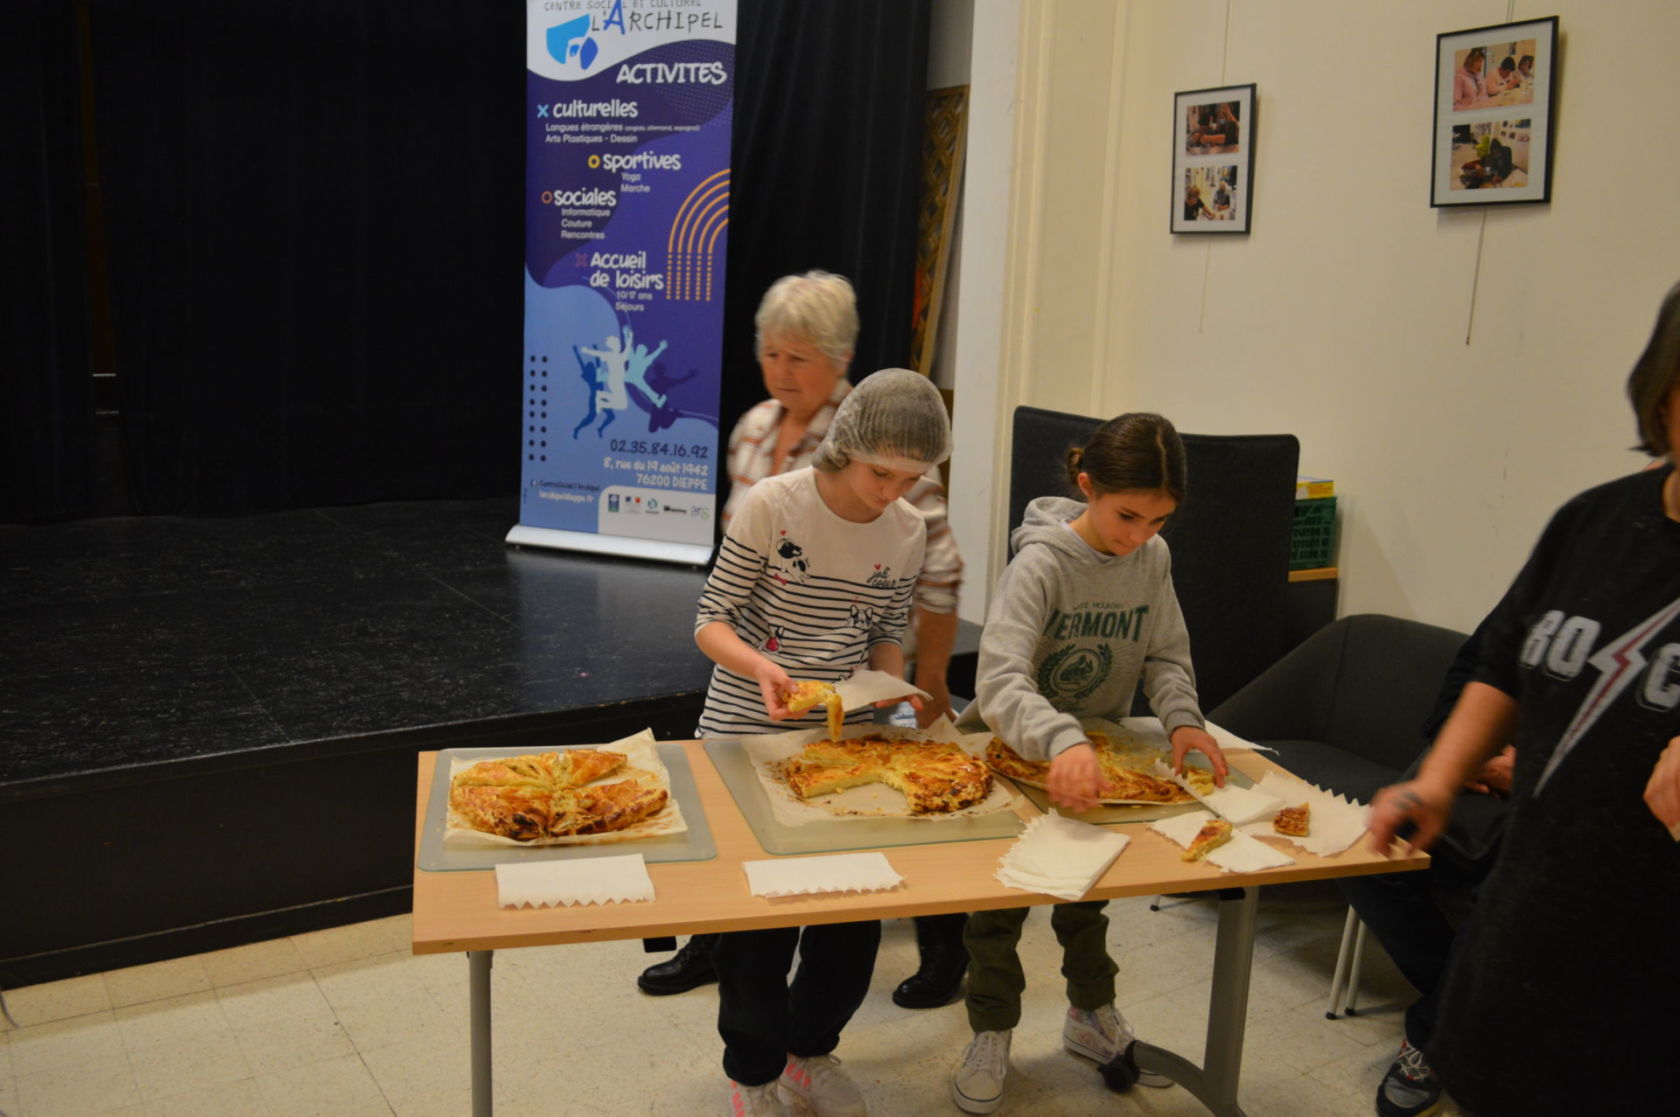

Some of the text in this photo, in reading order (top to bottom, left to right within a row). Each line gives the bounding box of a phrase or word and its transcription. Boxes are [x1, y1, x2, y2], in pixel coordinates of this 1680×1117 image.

[544, 0, 581, 11] CENTRE
[591, 0, 723, 35] L'ARCHIPEL
[616, 61, 728, 85] ACTIVITES
[552, 99, 639, 118] culturelles
[545, 123, 579, 132] Langues
[545, 134, 561, 143] Arts
[610, 134, 638, 143] Dessin
[602, 151, 682, 173] sportives
[621, 172, 641, 182] Yoga
[621, 184, 651, 193] Marche
[553, 187, 617, 207] sociales
[561, 207, 611, 217] Informatique
[561, 219, 592, 228] Couture
[561, 230, 605, 239] Rencontres
[590, 251, 646, 269] Accueil
[590, 270, 664, 290] de loisirs
[610, 438, 709, 459] 02.35.84.16.92
[682, 463, 709, 477] 1942
[636, 472, 709, 491] 76200 DIEPPE
